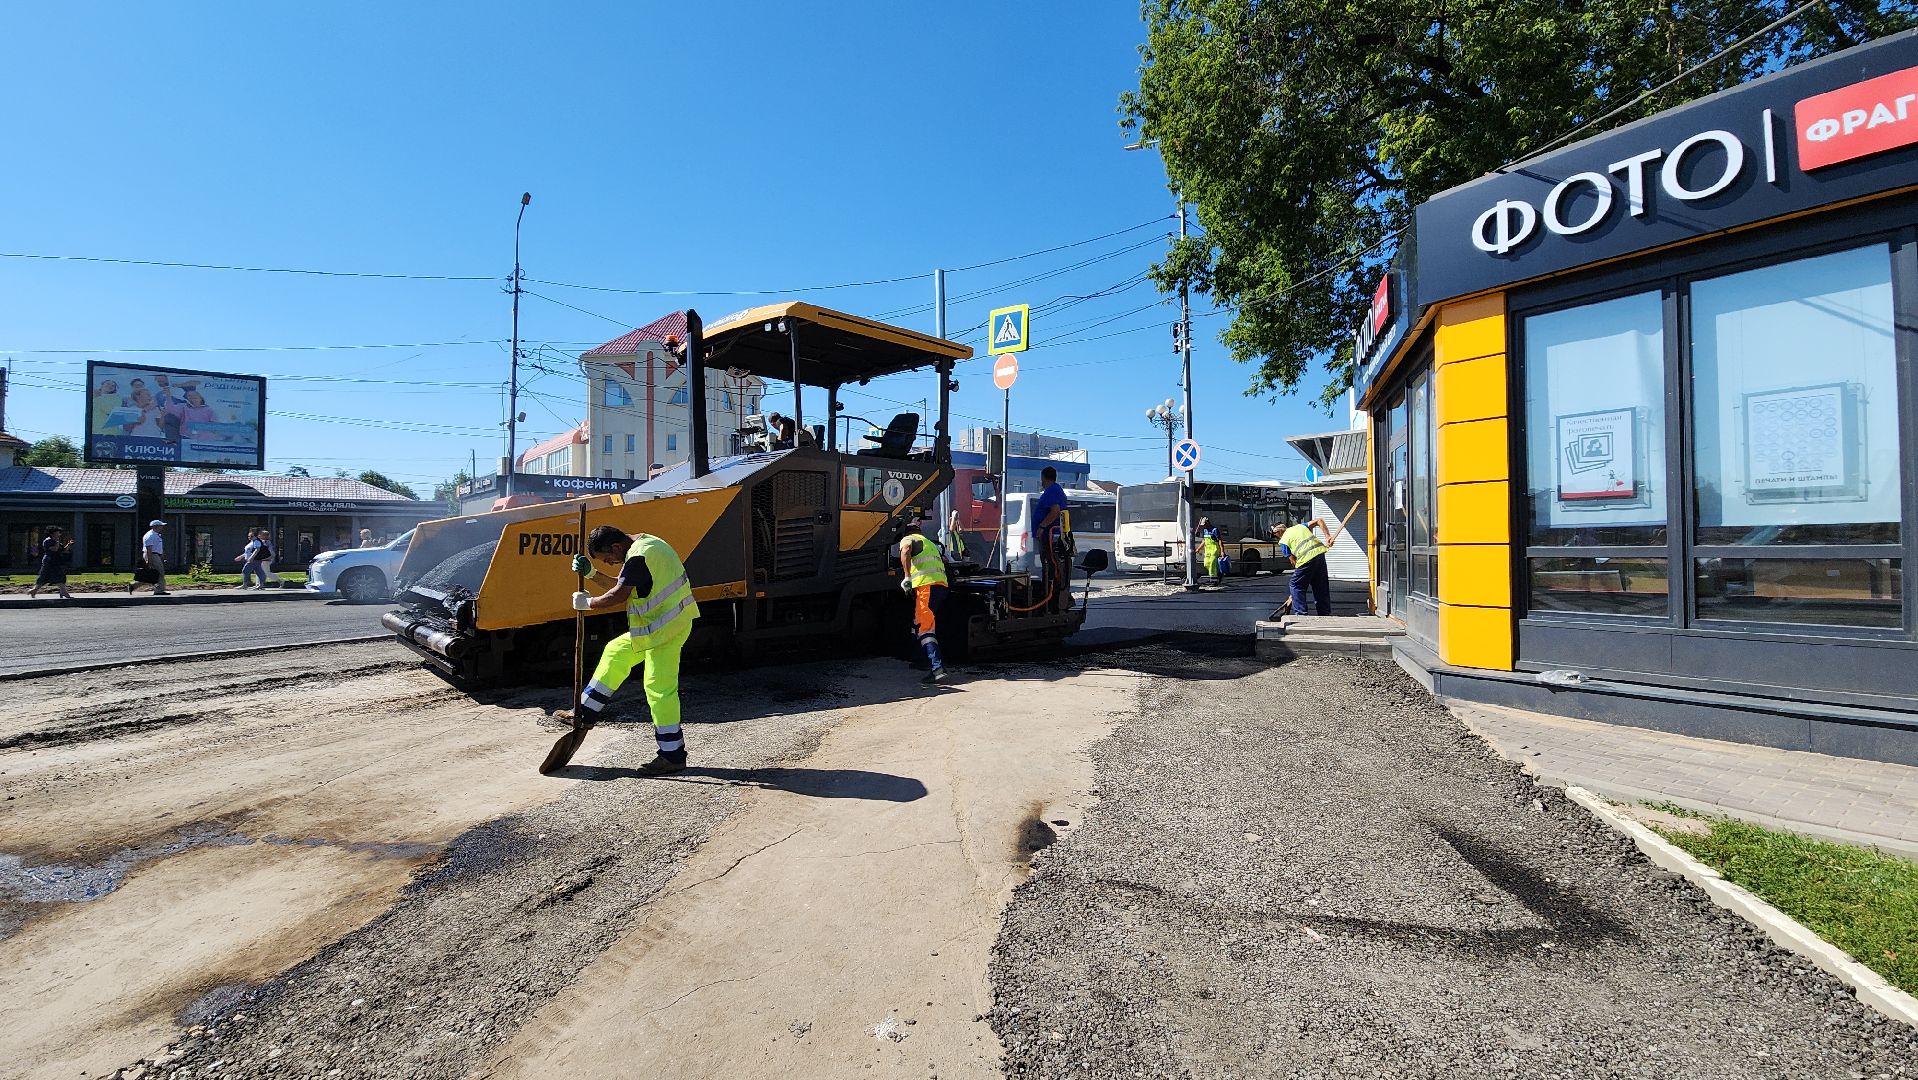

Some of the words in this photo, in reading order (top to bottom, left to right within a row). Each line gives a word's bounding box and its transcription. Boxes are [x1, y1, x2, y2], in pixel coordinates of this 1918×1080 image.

[1472, 130, 1744, 254] ФОТО
[1805, 93, 1916, 142] ФРАГ
[124, 445, 175, 455] КЛЮЧИ
[888, 471, 922, 480] VOLVO
[1754, 475, 1787, 485] ПЕЧАТИ
[1789, 475, 1796, 483] И
[1799, 473, 1839, 483] ШТАМПЫ
[553, 478, 618, 490] кофейня
